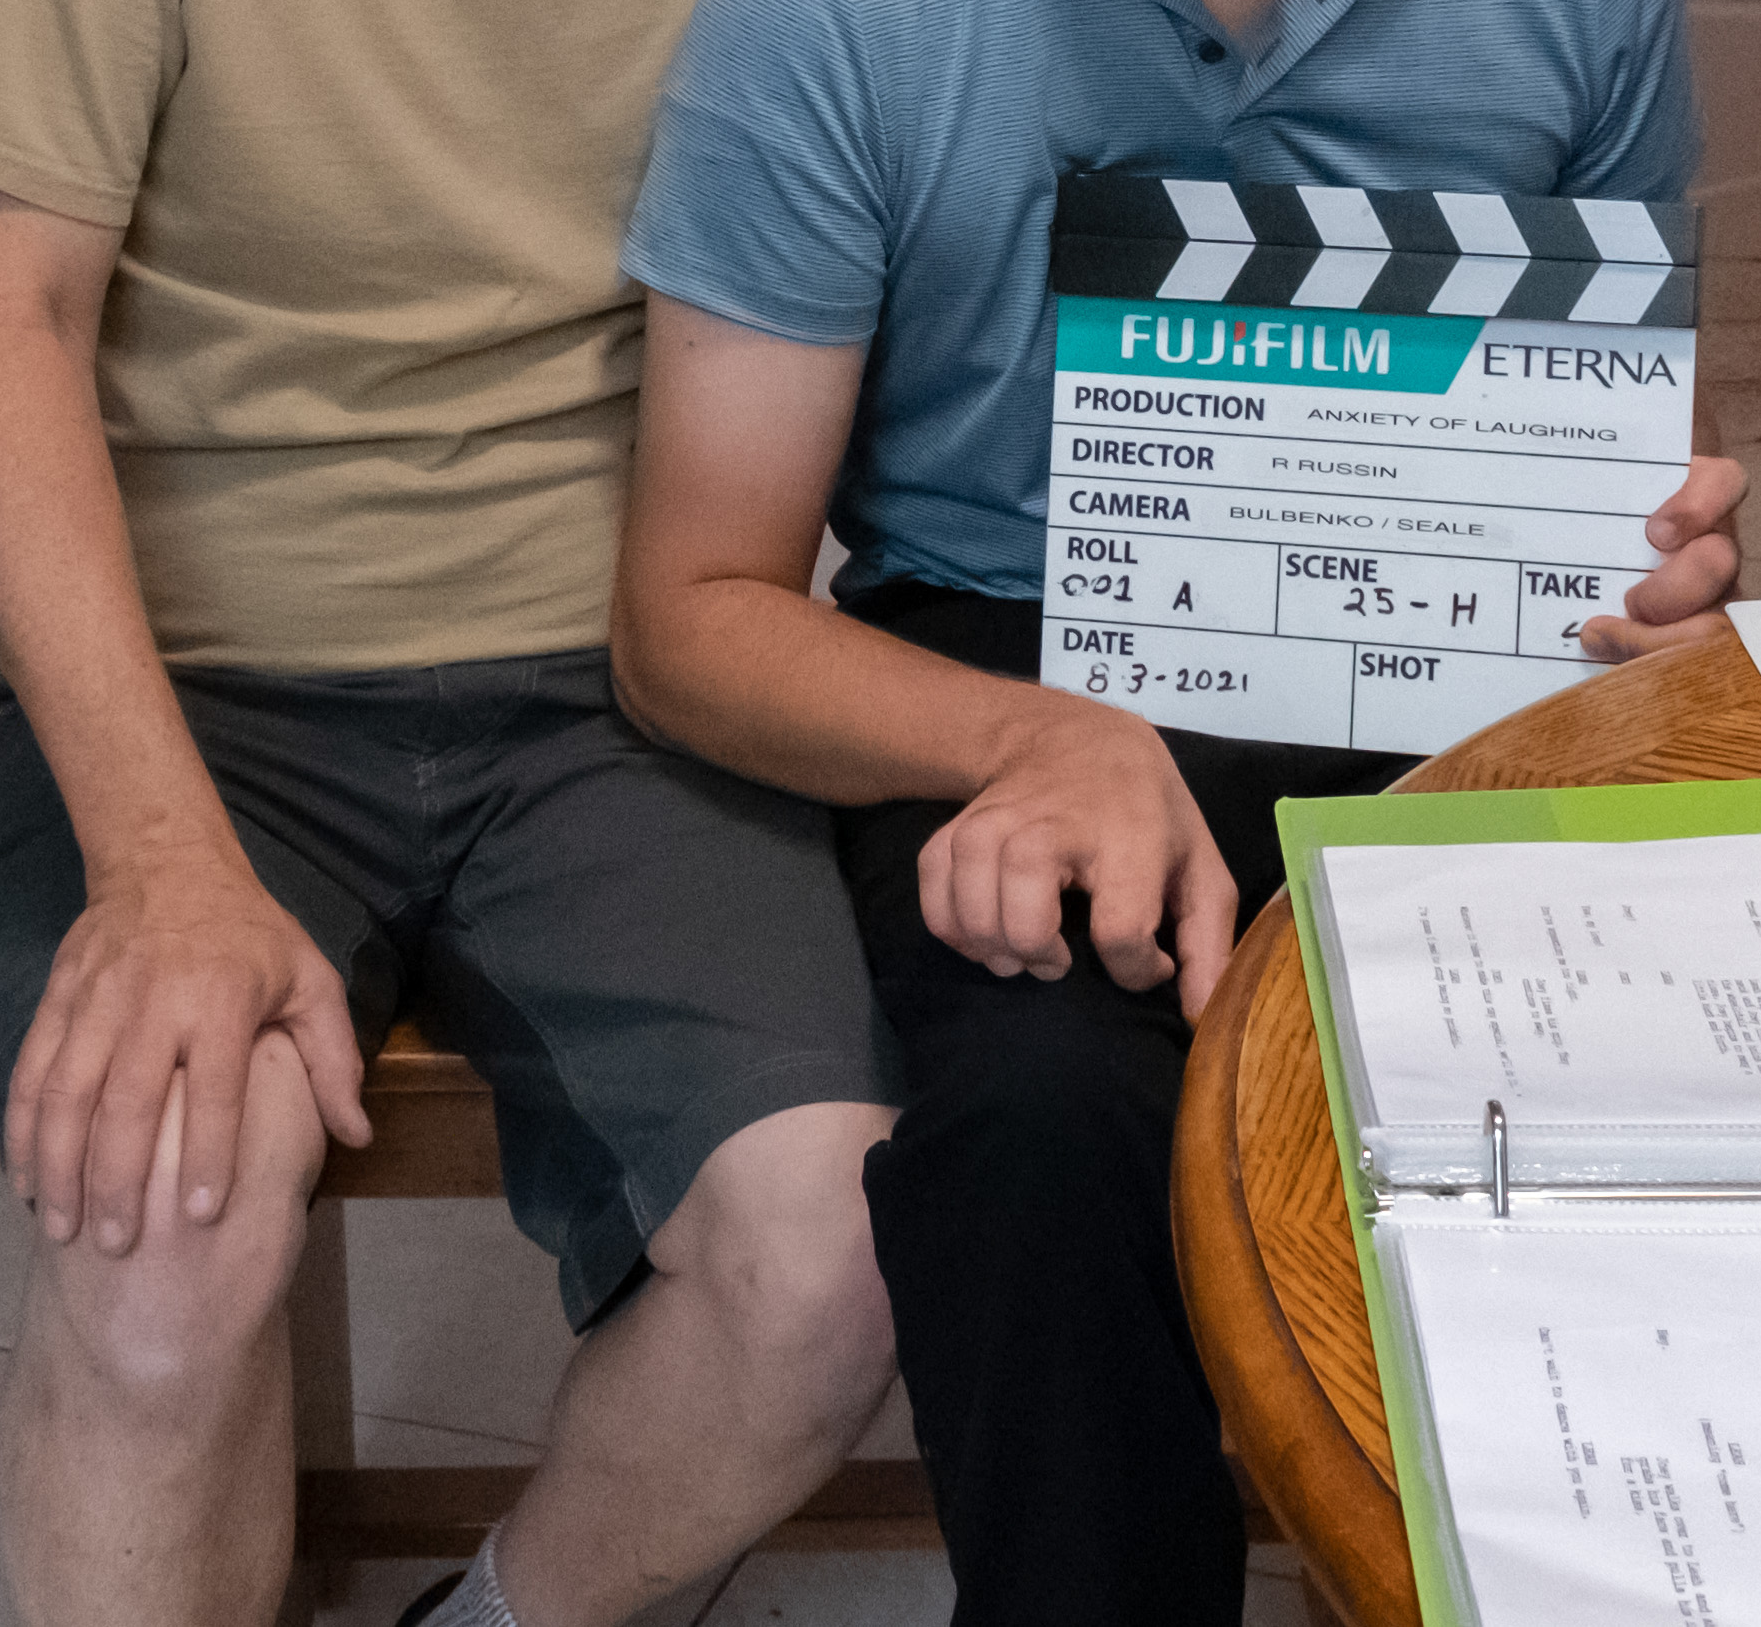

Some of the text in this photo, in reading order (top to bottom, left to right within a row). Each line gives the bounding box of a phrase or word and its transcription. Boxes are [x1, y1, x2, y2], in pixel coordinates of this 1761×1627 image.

[1120, 314, 1390, 375] FUJIFILM
[1483, 342, 1678, 389] ETERNA
[1074, 386, 1618, 442] PRODUCTION ANXIETY OF LAUGHING
[1072, 437, 1398, 479] DIRECTOR R RUSSIN
[1069, 489, 1485, 537] CAMERA BULBENKO / SEALE
[1067, 536, 1138, 565] ROLL
[1285, 552, 1378, 583] SCENE
[1059, 574, 1194, 612] 001 A
[1525, 571, 1601, 601] TAKE
[1063, 627, 1134, 657] DATE
[1359, 652, 1441, 682] SHOT
